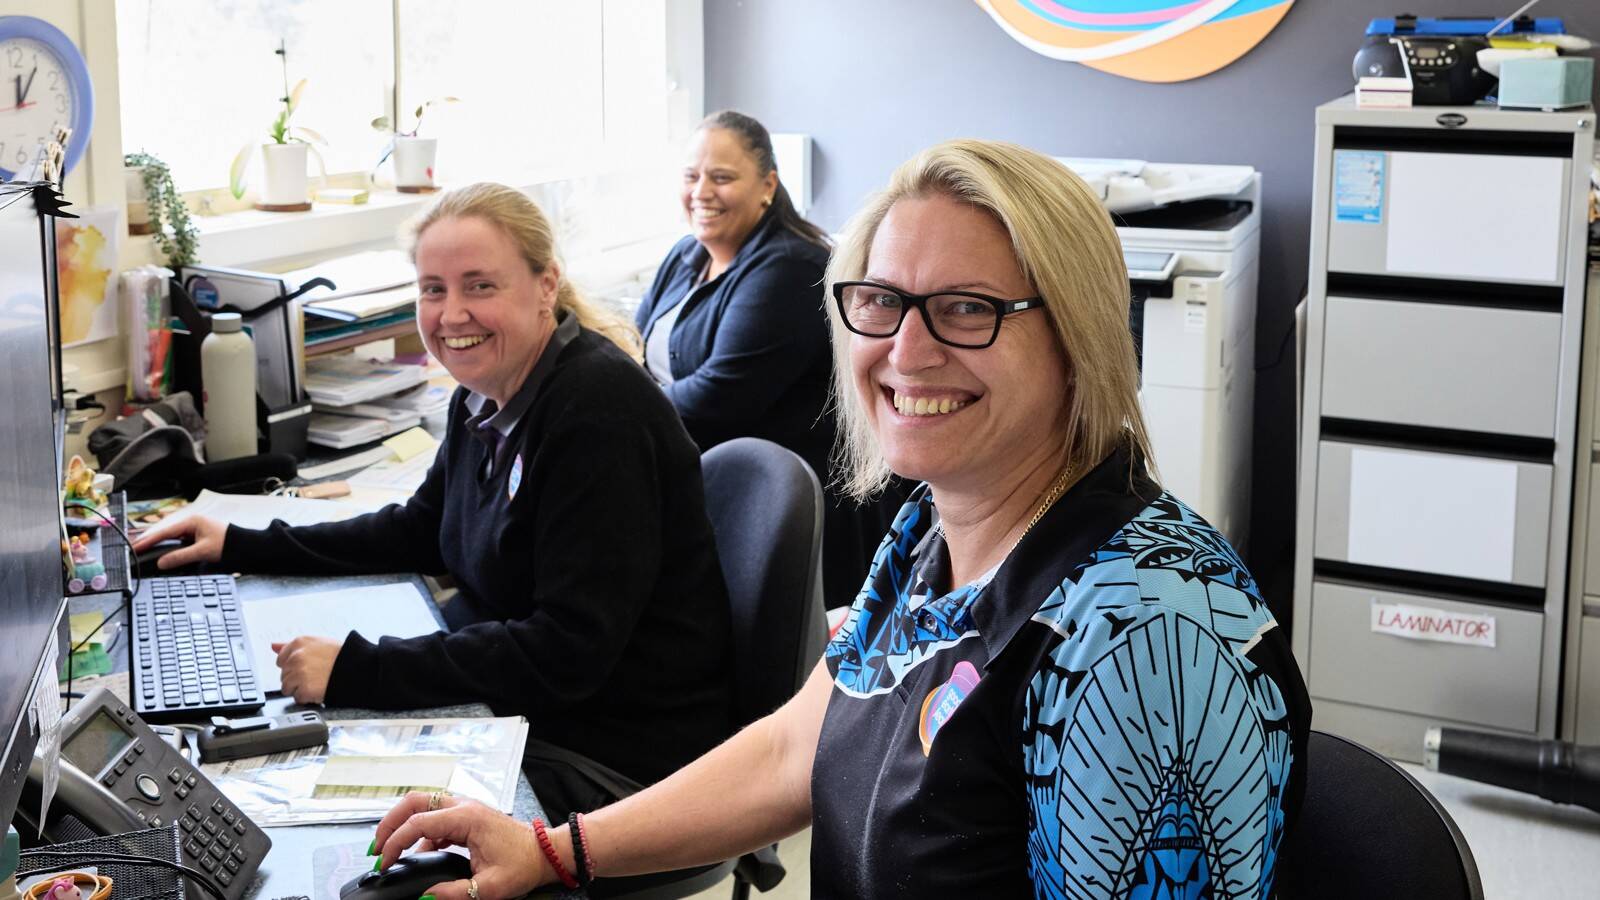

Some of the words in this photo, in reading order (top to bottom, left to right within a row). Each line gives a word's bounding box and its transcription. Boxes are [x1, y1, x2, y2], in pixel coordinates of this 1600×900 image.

[6, 46, 23, 68] 12
[48, 70, 58, 91] 2
[55, 93, 66, 114] 3
[15, 144, 28, 165] 6
[1378, 609, 1490, 639] LAMINATOR
